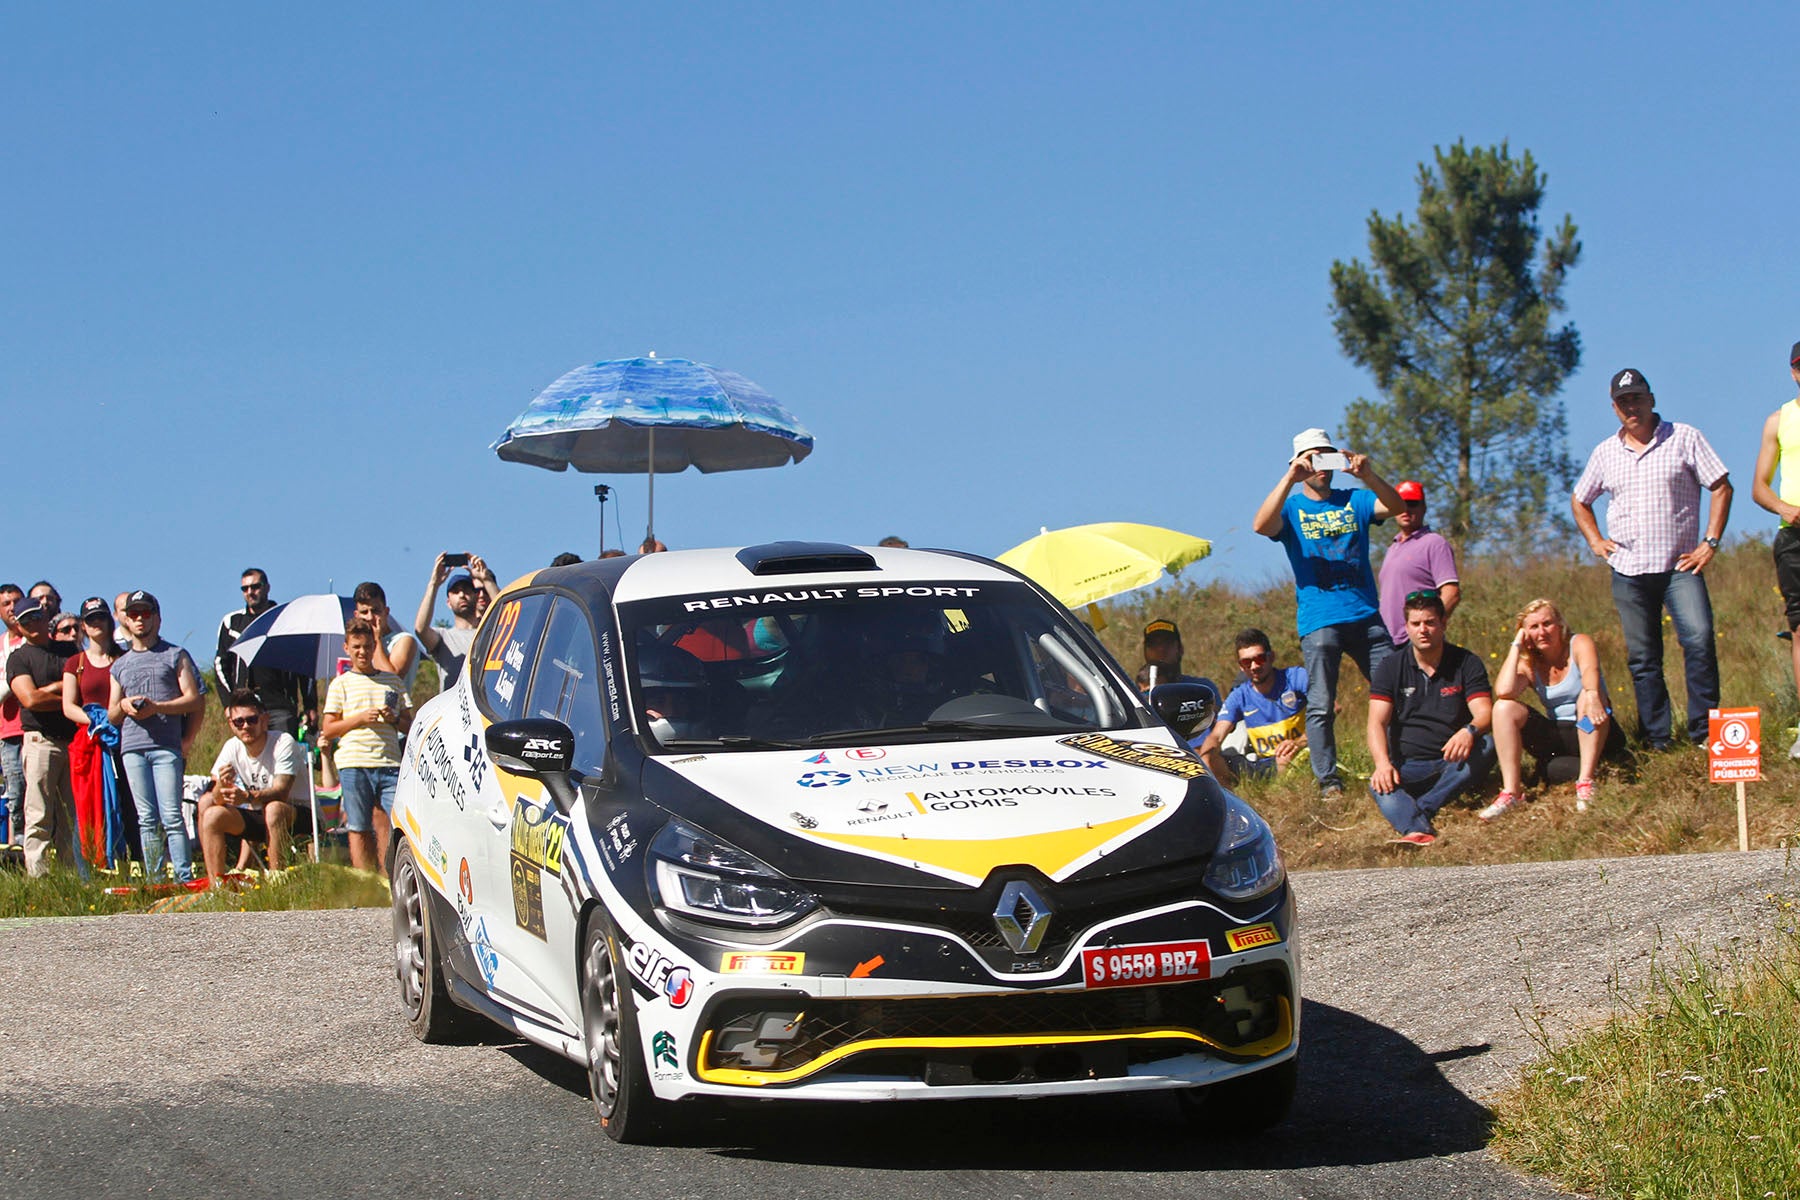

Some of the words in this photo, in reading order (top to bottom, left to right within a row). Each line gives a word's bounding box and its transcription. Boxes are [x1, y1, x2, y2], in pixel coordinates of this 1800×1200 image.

[1303, 531, 1321, 540] THE
[1083, 564, 1132, 583] DUNLOP
[683, 589, 847, 613] RENAULT
[858, 586, 980, 598] SPORT
[484, 600, 522, 671] 22
[1180, 699, 1204, 713] ARC
[524, 738, 562, 751] ARC
[855, 748, 877, 759] E
[426, 726, 466, 812] AUTOMÓVILES
[469, 747, 487, 794] RS
[857, 763, 939, 778] NEW
[951, 759, 1110, 770] DESBOX
[1712, 759, 1758, 768] PROHIBIDO
[1714, 767, 1757, 779] PÚBLICO
[417, 753, 438, 799] GOMIS
[865, 770, 949, 784] RECICLAJE
[923, 785, 1117, 801] AUTOMÓVILES
[930, 798, 1019, 812] GOMIS
[847, 810, 914, 827] RENAULT
[545, 822, 564, 873] 22
[1233, 925, 1277, 947] PIRELLI
[629, 941, 674, 989] elf
[1092, 956, 1106, 982] S
[1109, 952, 1156, 980] 9558
[1160, 950, 1199, 977] BBZ
